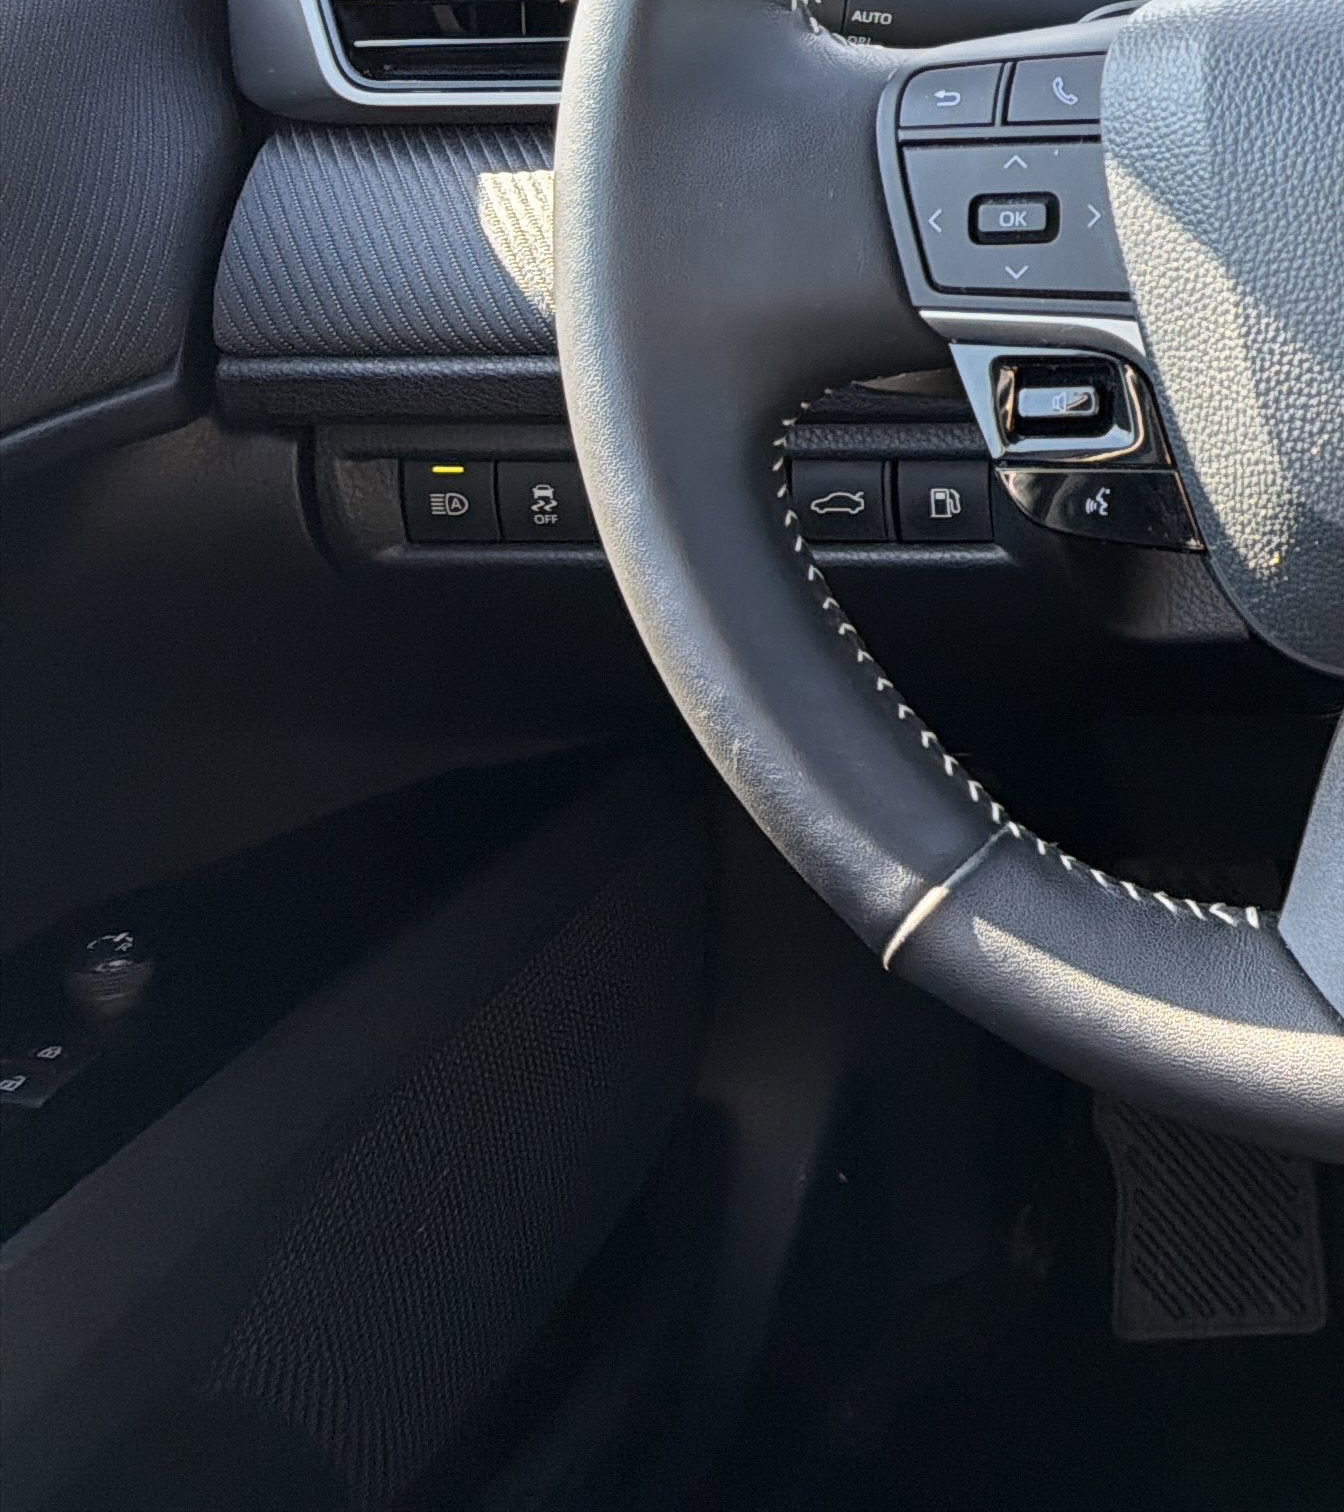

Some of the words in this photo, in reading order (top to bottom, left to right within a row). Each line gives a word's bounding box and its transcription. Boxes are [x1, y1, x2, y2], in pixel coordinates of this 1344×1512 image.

[851, 10, 893, 25] AUTO
[999, 210, 1027, 227] OK
[534, 514, 559, 525] OFF
